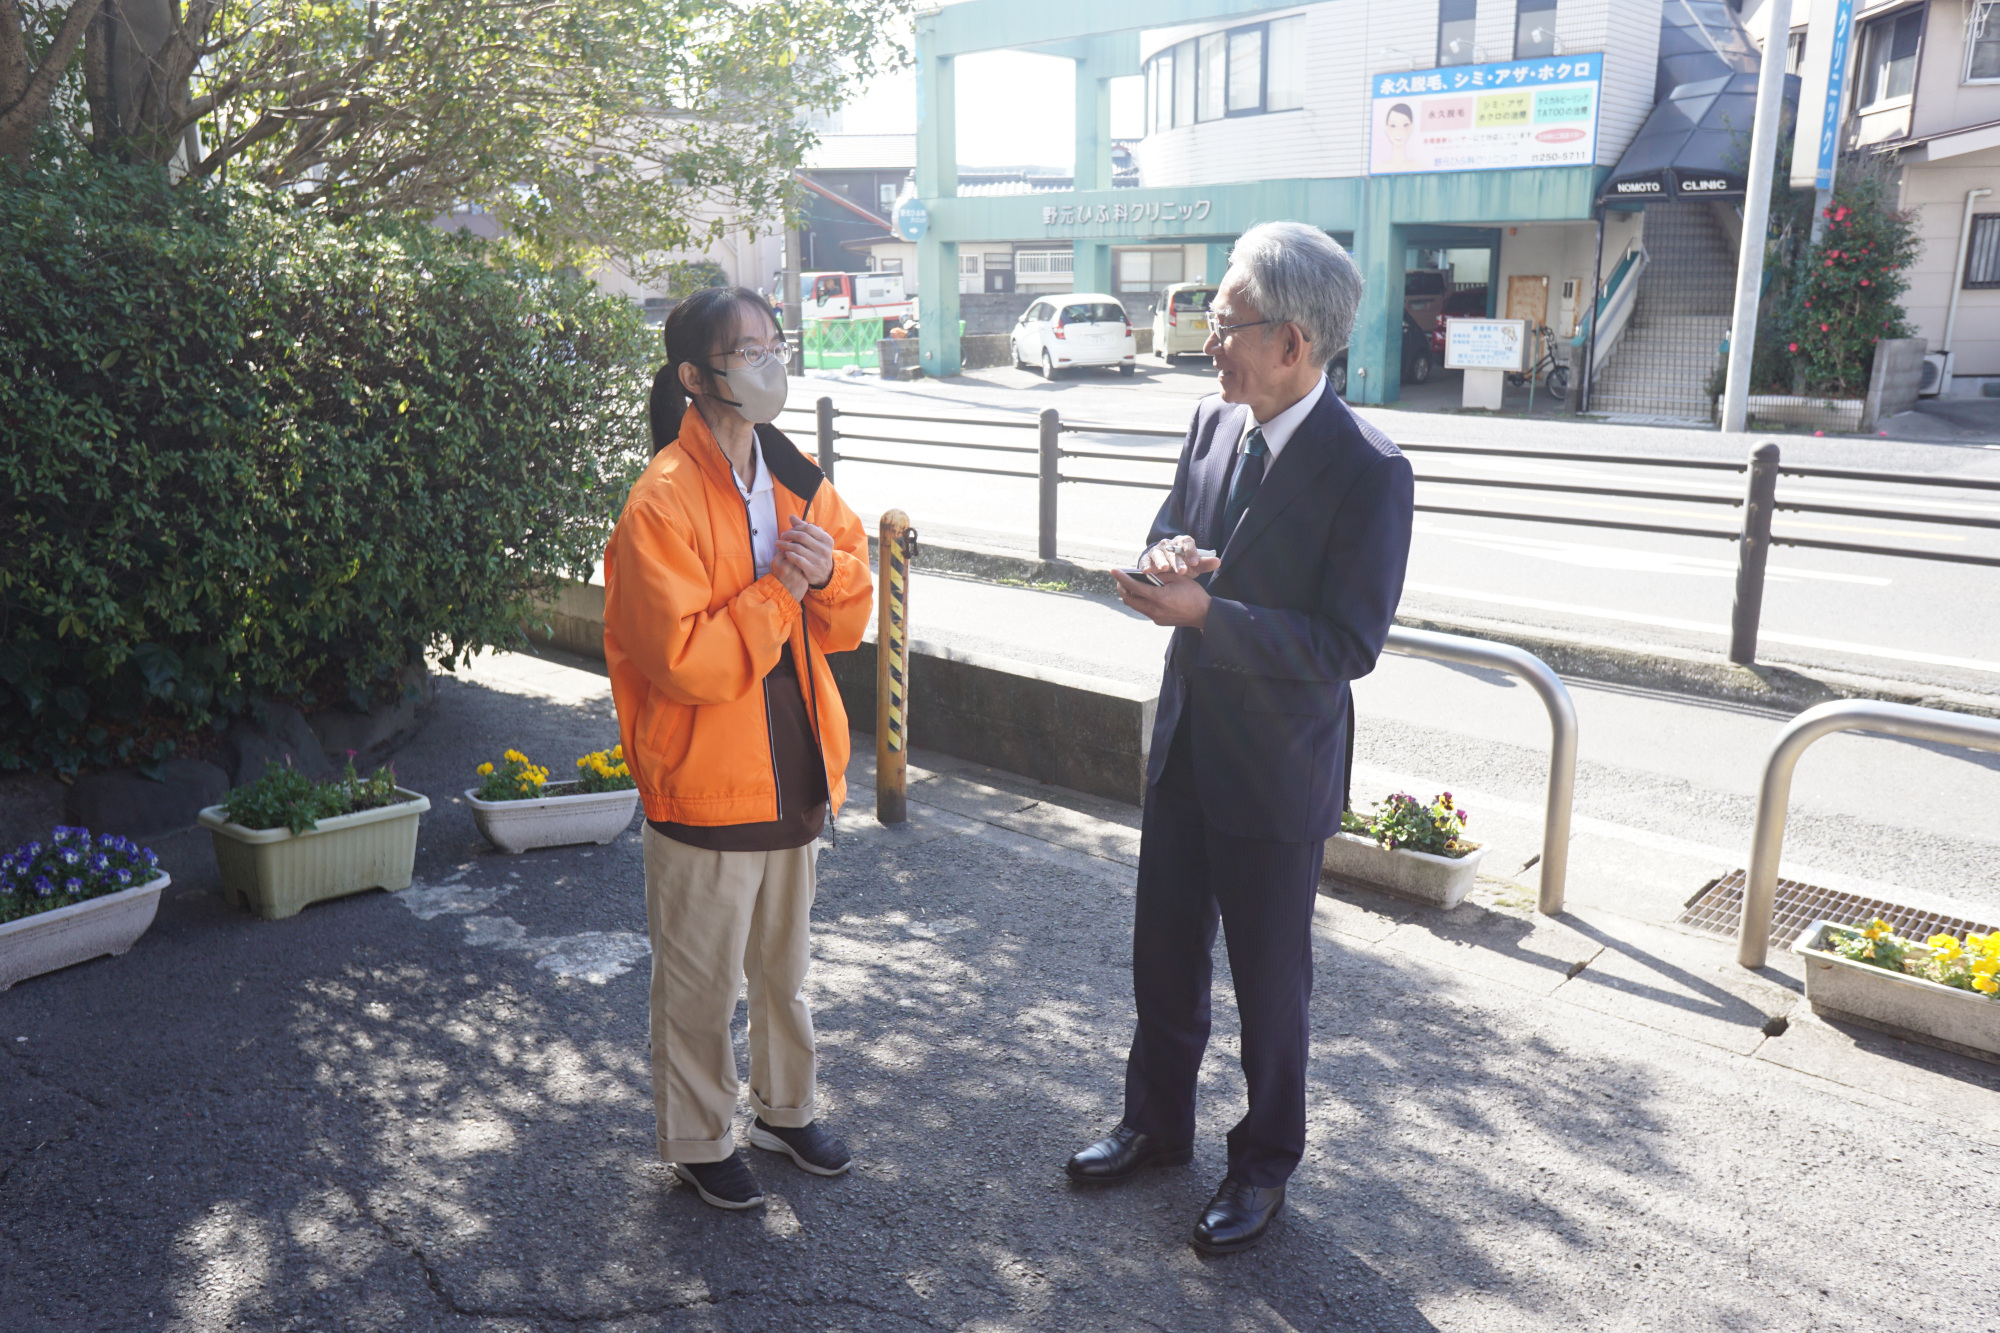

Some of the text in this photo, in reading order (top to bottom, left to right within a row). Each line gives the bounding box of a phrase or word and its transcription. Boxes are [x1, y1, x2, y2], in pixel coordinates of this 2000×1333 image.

[1823, 0, 1850, 155] クリニック
[1617, 180, 1727, 192] NOMOTO CLINIC
[1042, 199, 1211, 225] 野元ひふ科クリニック
